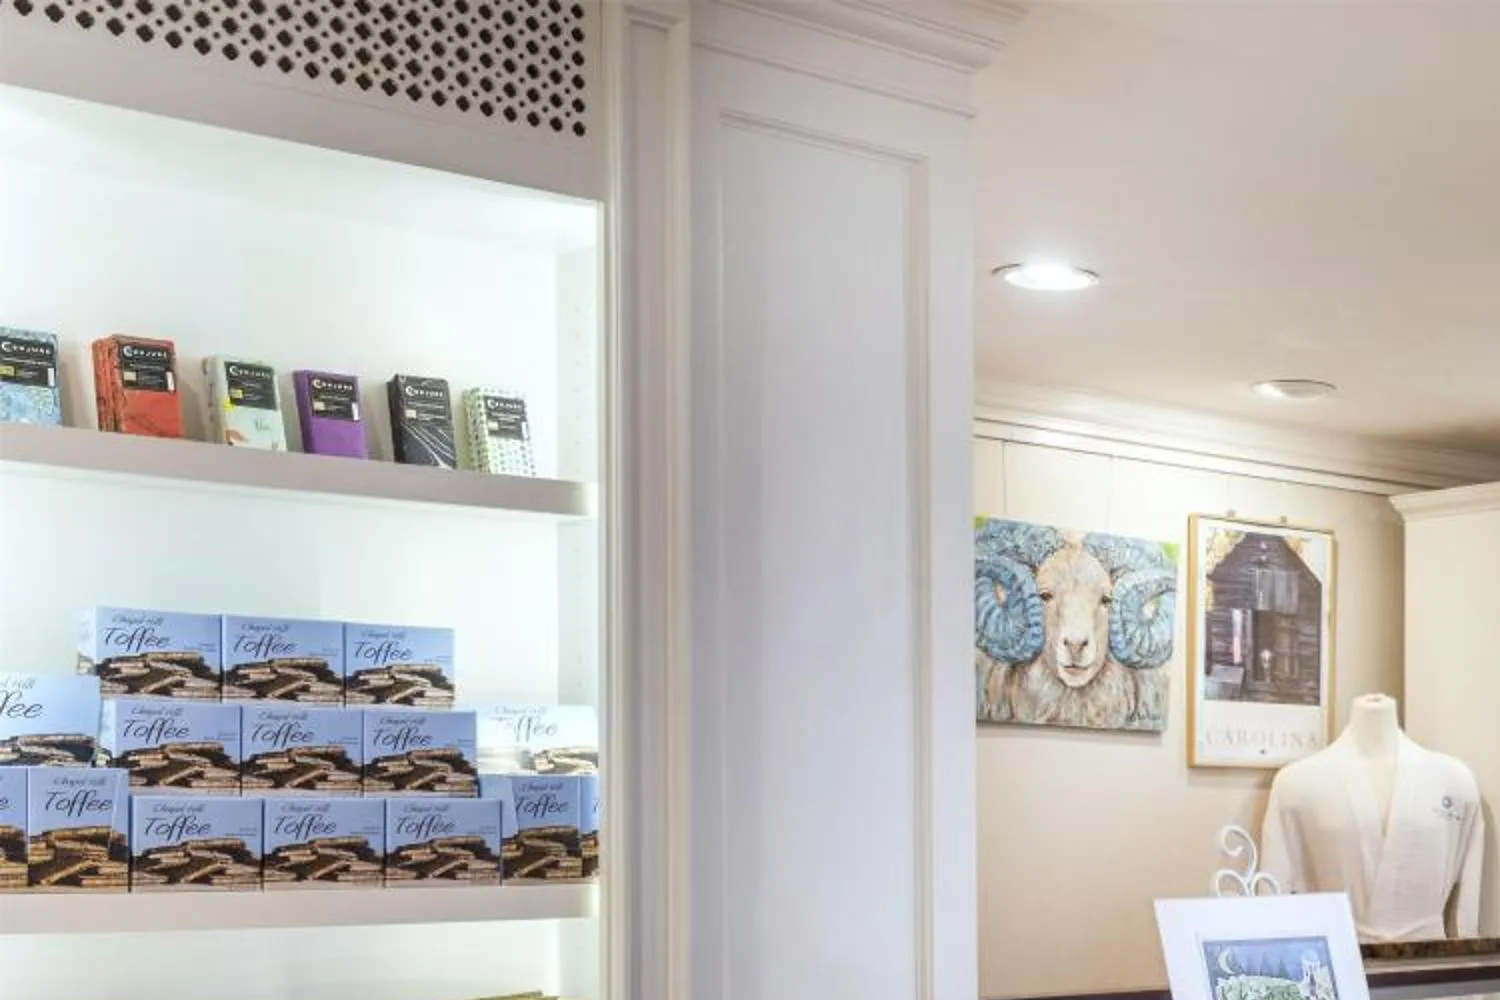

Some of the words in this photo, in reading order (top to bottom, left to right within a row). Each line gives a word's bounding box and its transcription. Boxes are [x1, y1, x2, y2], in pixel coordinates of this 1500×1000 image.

[103, 626, 171, 652] Toffee
[233, 633, 298, 658] Toffee
[354, 640, 413, 665] Toffee
[124, 717, 190, 744] Toffee
[252, 721, 315, 748] Toffee
[373, 725, 432, 750] Toffee
[45, 789, 113, 817] Toffee
[515, 793, 568, 817] Toffee
[144, 815, 211, 841] Toffee
[275, 814, 337, 840] Toffee
[397, 814, 455, 840] Toffee
